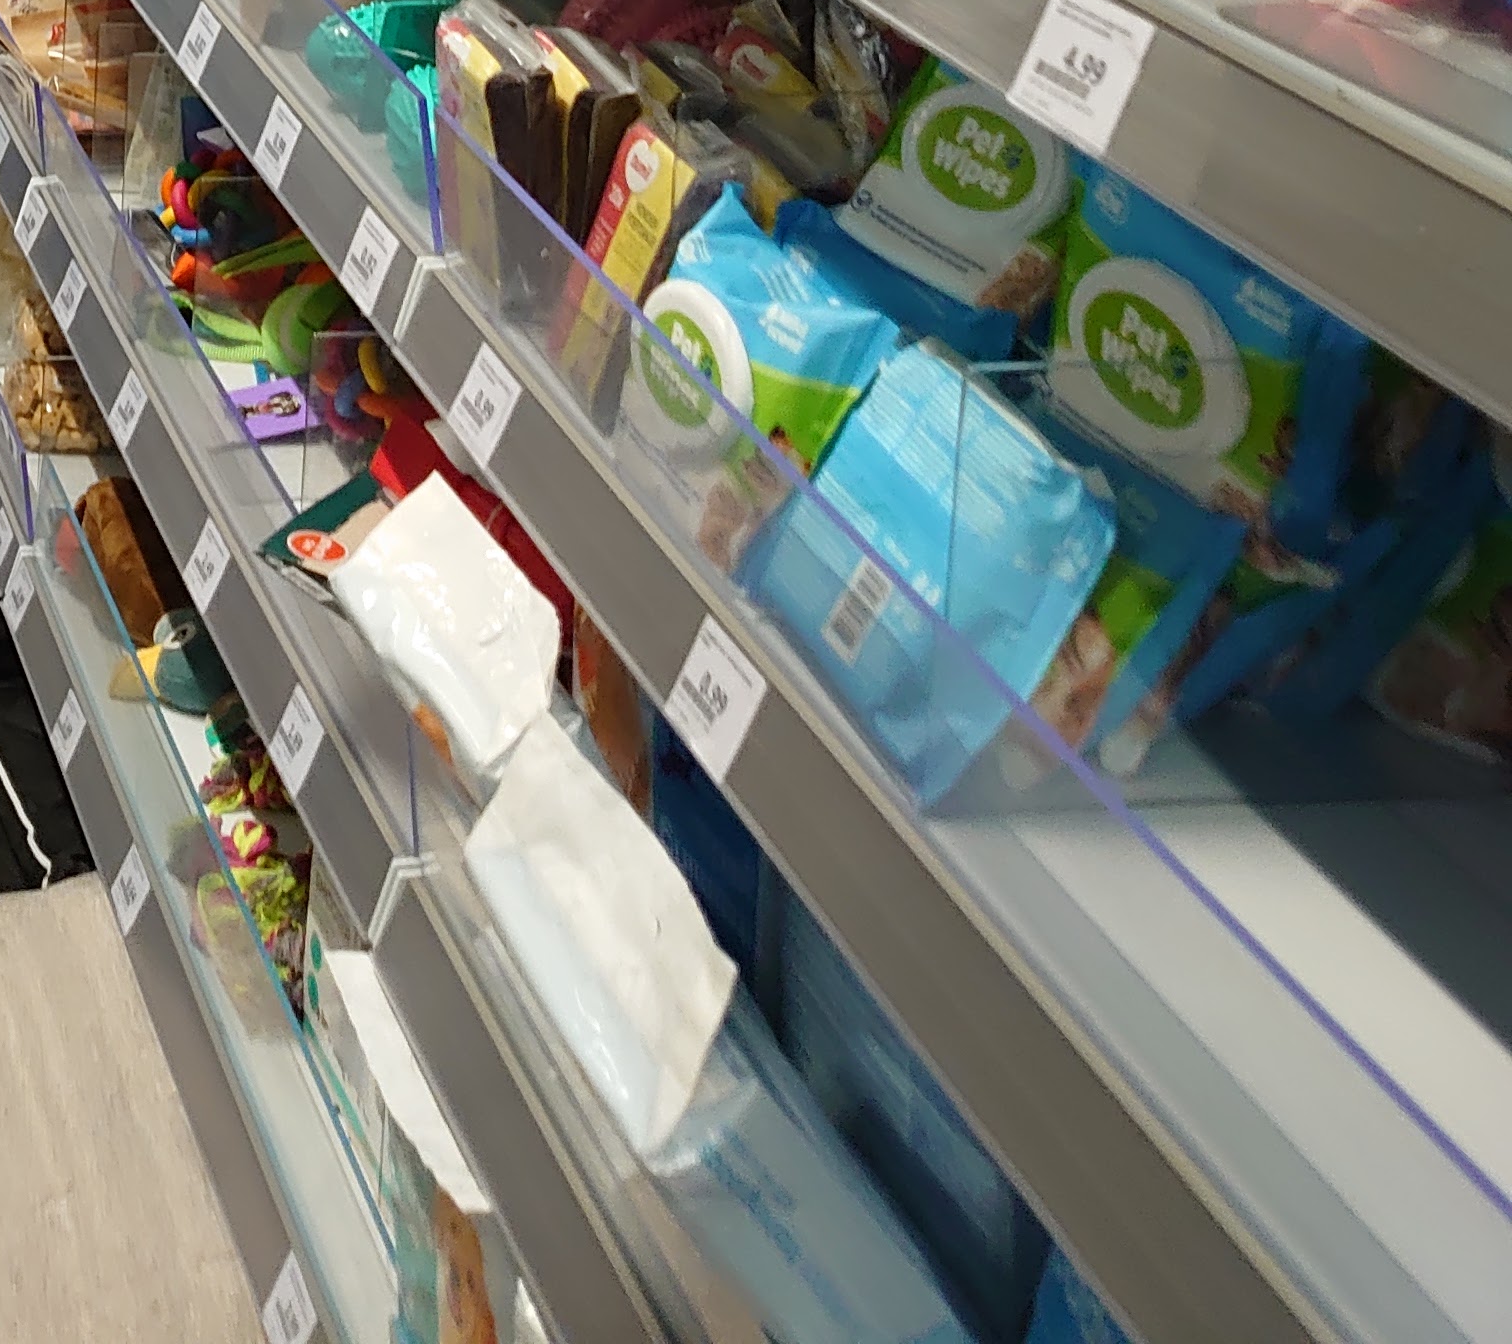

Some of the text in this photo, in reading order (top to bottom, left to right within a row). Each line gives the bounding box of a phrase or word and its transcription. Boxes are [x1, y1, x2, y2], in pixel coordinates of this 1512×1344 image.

[1063, 45, 1107, 87] 4.99
[956, 115, 1004, 160] Pet
[934, 138, 1012, 199] Wipes
[1121, 304, 1168, 363] Pet
[1101, 328, 1182, 415] Wipes
